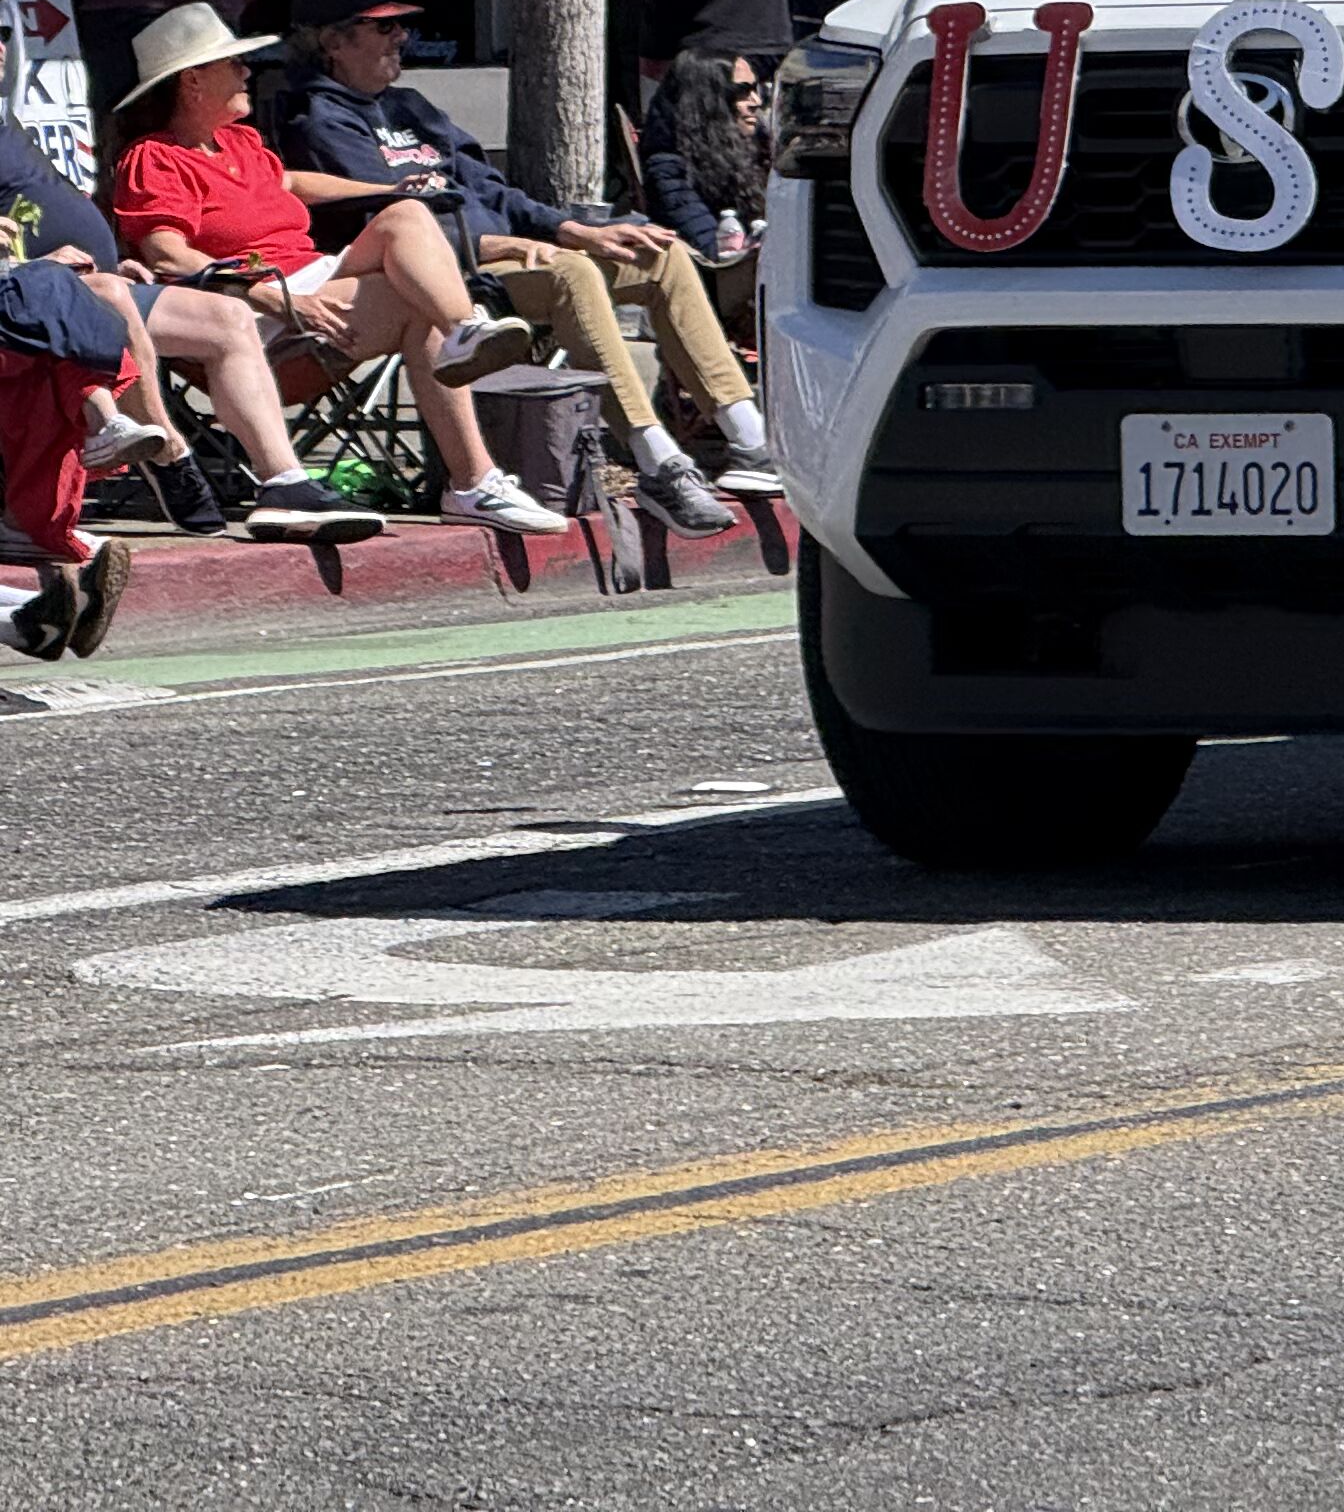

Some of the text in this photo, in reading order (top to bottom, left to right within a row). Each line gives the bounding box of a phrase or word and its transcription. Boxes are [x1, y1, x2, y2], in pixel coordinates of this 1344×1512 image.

[1173, 432, 1282, 449] CA EXEMPT
[1137, 460, 1319, 517] 1714020
